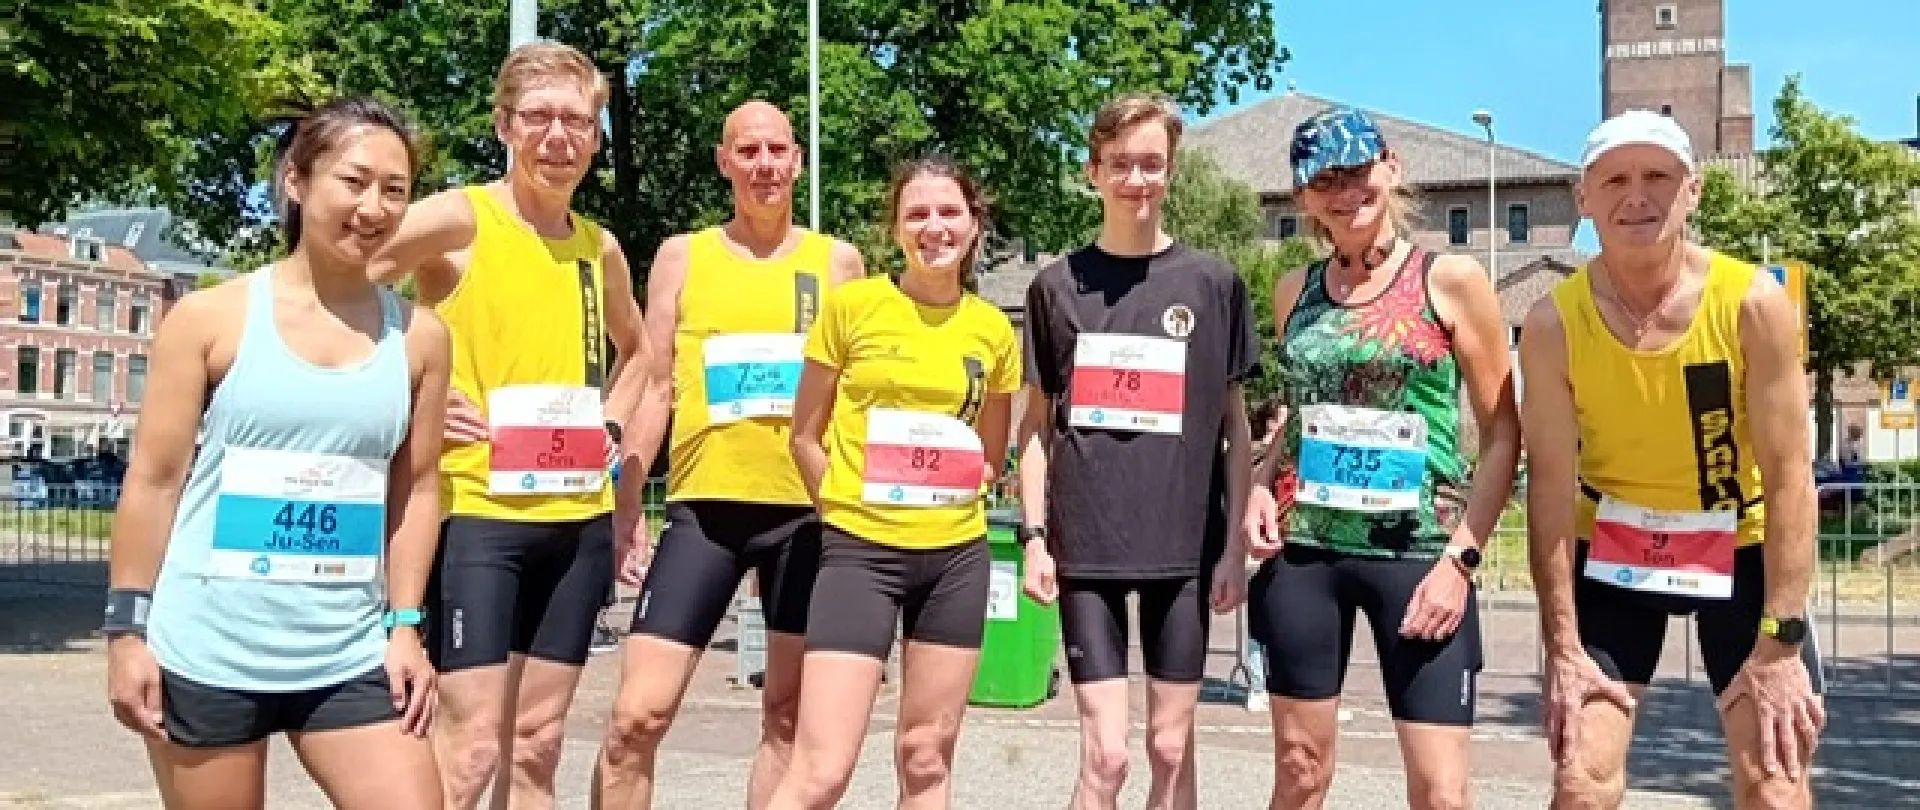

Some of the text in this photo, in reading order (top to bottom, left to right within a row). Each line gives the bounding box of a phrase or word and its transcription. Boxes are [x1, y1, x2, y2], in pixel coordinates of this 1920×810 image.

[1112, 369, 1141, 393] 78
[552, 428, 565, 453] 5
[912, 447, 940, 471] 82
[1333, 444, 1381, 472] 735
[273, 501, 337, 534] 446
[264, 531, 340, 551] Ju-Sen
